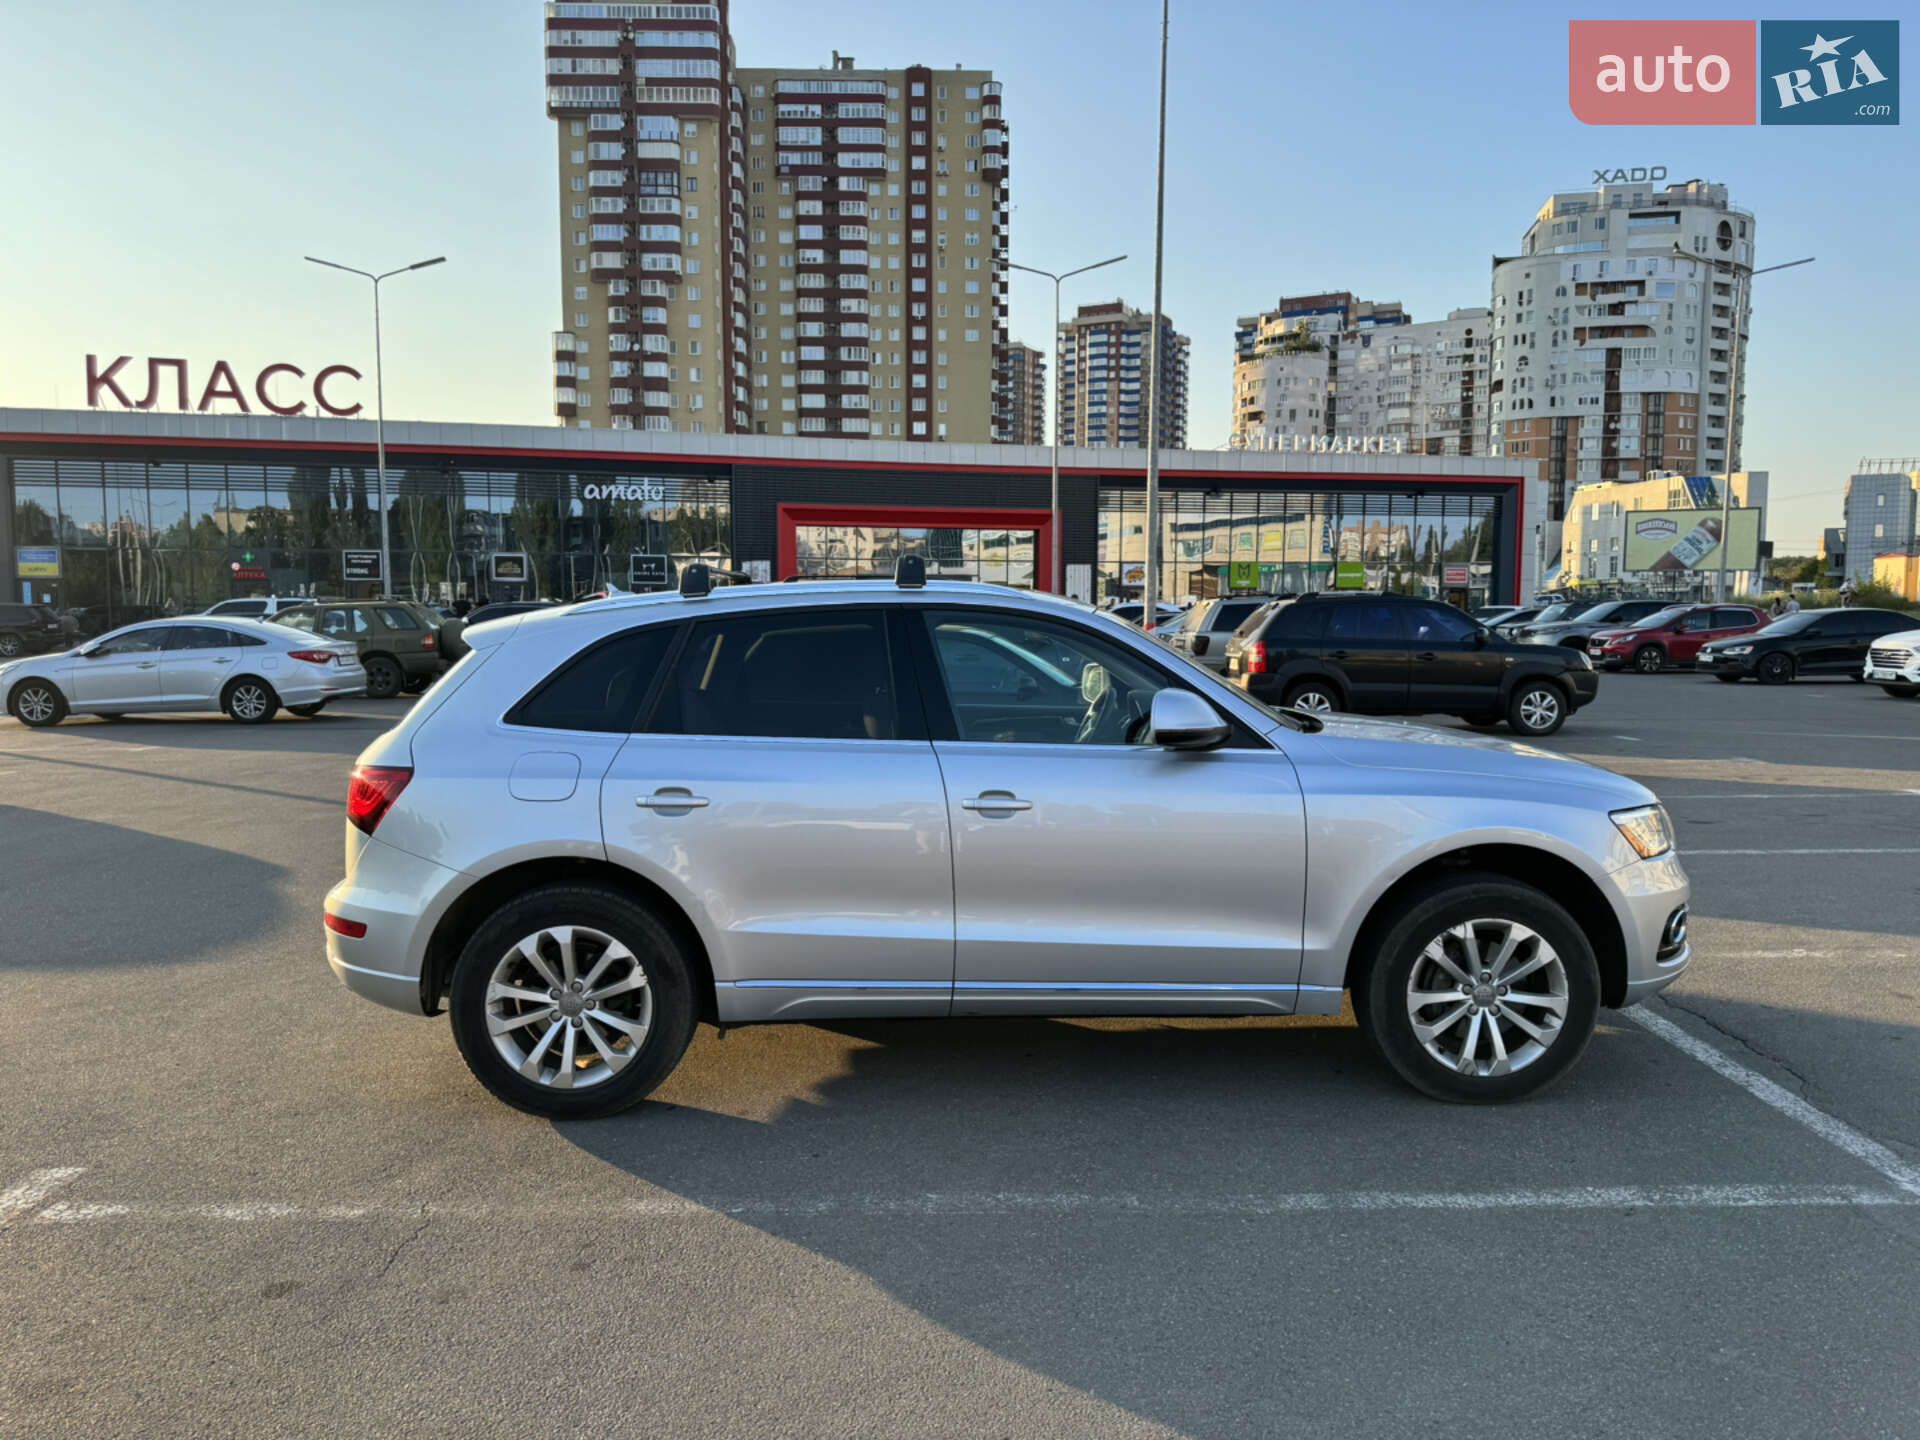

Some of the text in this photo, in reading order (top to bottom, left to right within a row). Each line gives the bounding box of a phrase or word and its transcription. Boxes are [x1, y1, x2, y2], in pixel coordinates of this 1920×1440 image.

[1592, 166, 1667, 184] XADO
[86, 353, 363, 416] КЛАСС
[1229, 433, 1408, 455] СУПЕРМАРКЕТ
[583, 477, 664, 501] amato
